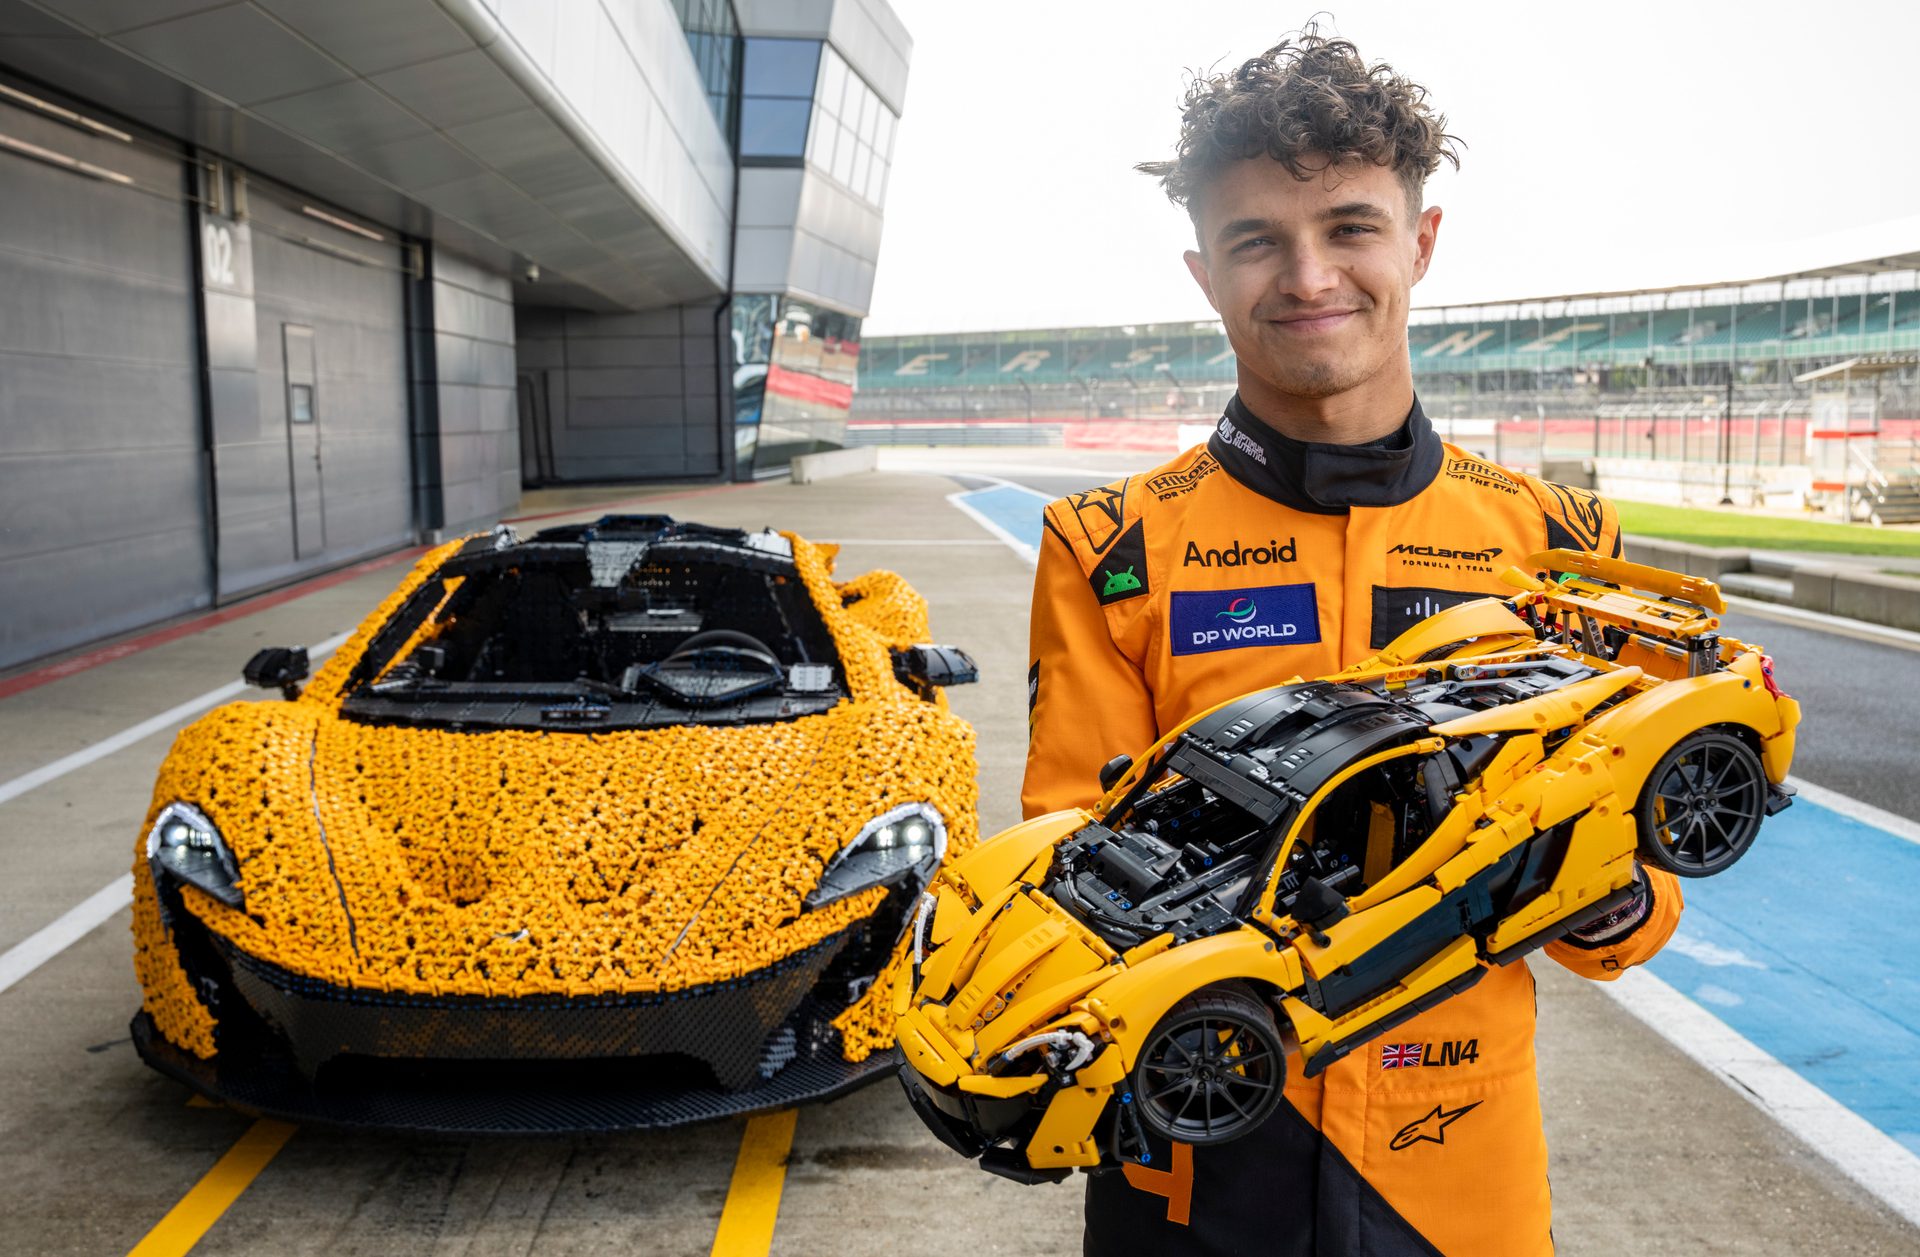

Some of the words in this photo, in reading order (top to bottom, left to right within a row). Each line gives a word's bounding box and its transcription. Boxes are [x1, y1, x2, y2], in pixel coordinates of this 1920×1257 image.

[205, 223, 234, 284] 02
[1232, 437, 1267, 466] NUTRITION
[1235, 430, 1265, 456] OPTIMUM
[1152, 460, 1210, 490] Hilton
[1158, 491, 1179, 502] FOR
[1180, 482, 1198, 495] THE
[1198, 464, 1220, 480] STAY
[1469, 475, 1490, 487] THE
[1493, 483, 1519, 495] STAY
[1183, 537, 1297, 567] Android
[1386, 544, 1491, 562] McLaren
[1402, 559, 1451, 569] FORMULA
[1465, 565, 1494, 573] TEAM
[1192, 630, 1220, 645] DP
[1221, 623, 1298, 641] WORLD
[1421, 1038, 1480, 1067] LN4
